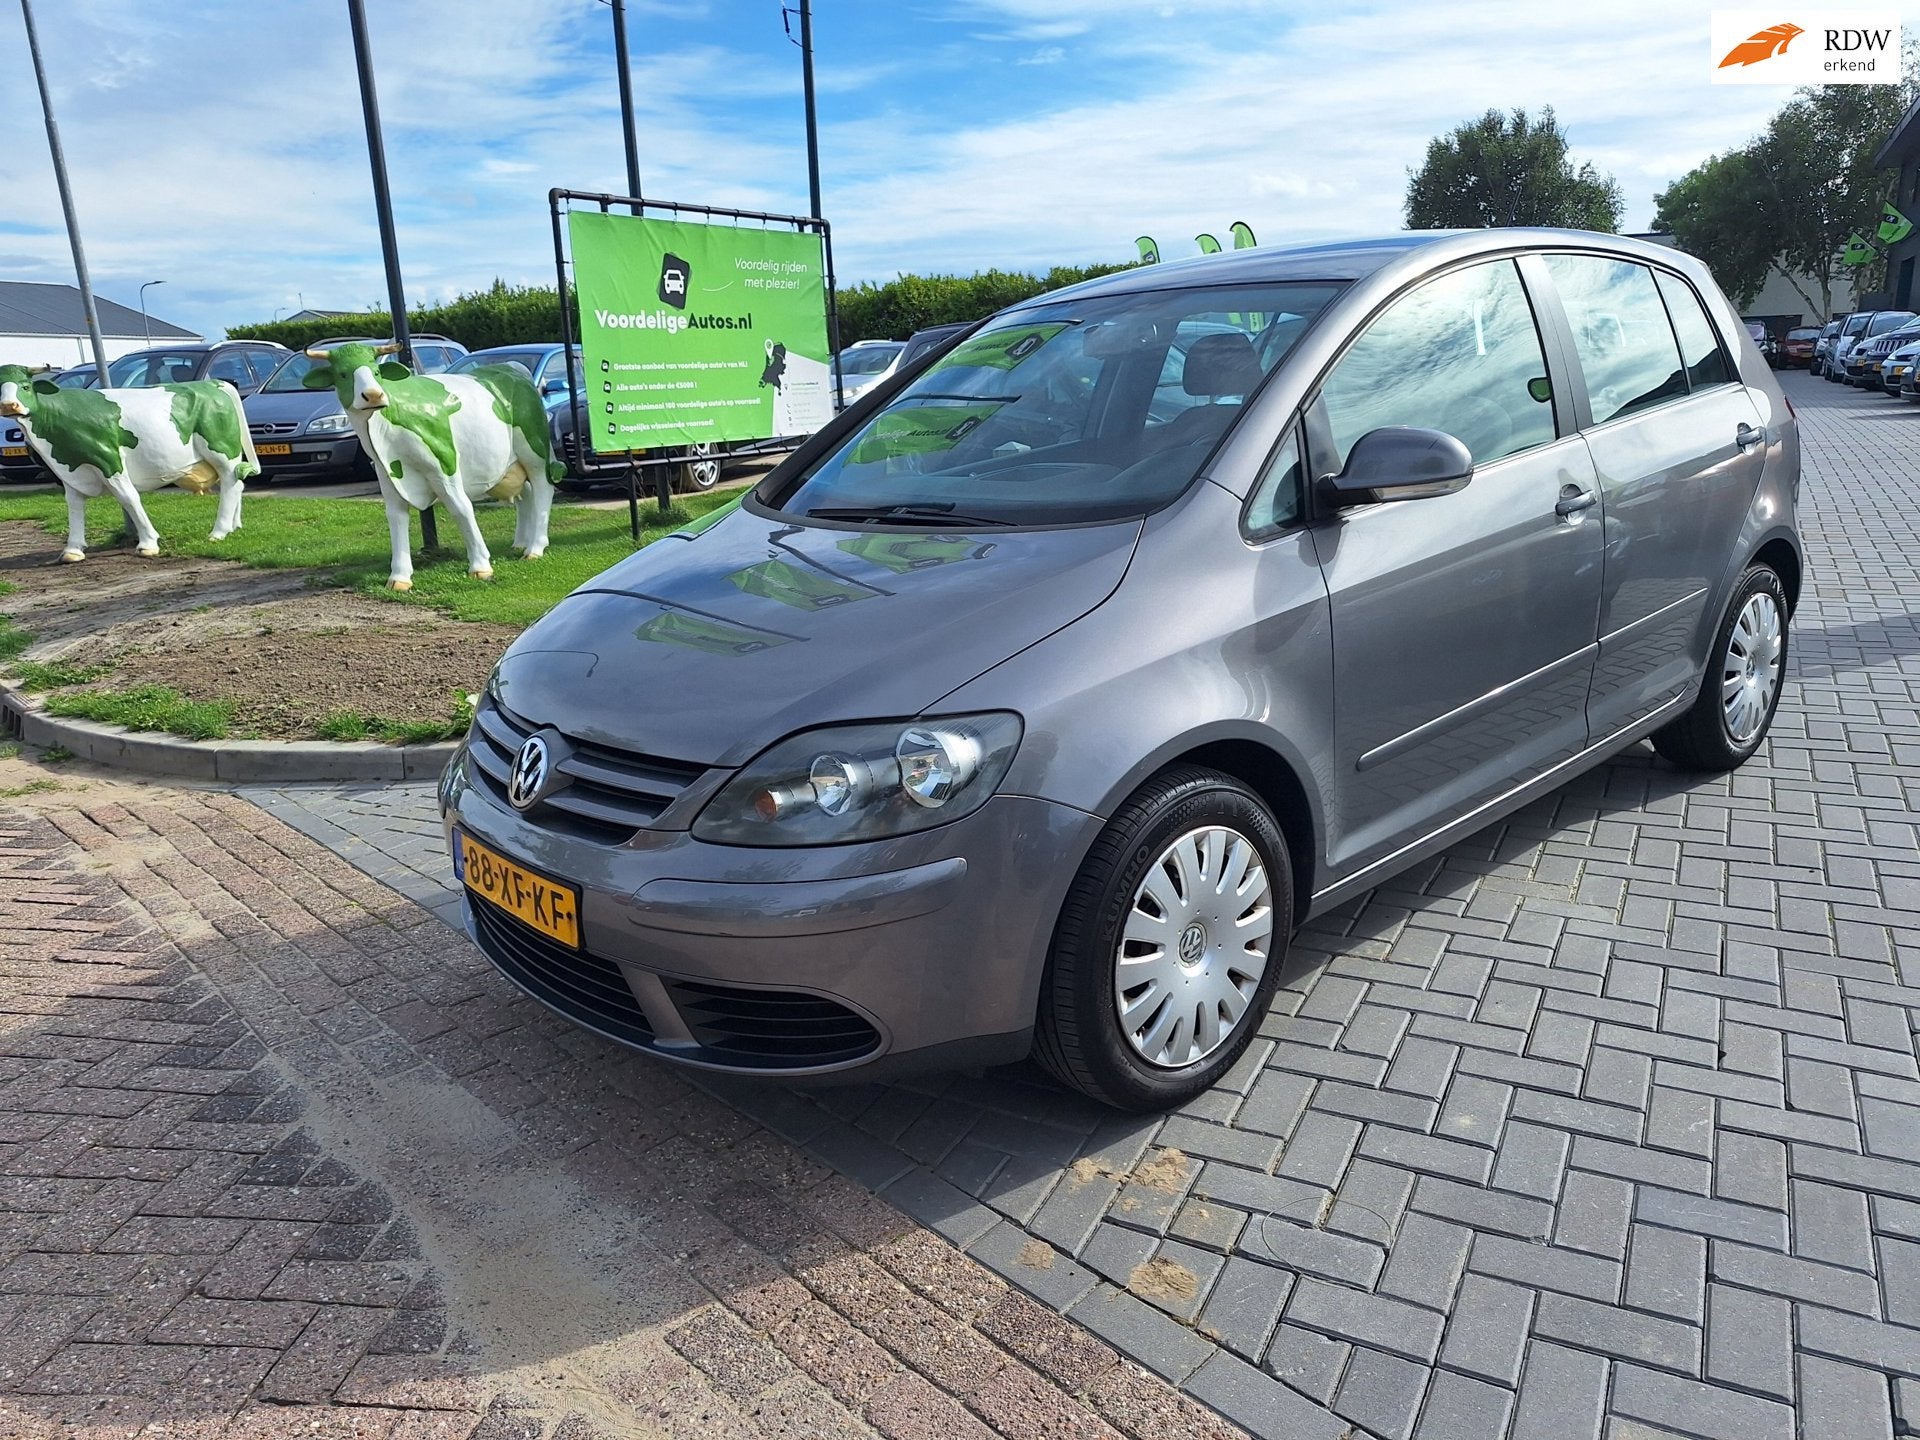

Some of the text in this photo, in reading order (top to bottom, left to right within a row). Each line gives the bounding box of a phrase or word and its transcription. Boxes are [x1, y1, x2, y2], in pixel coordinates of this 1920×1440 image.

[734, 257, 808, 276] Voordelig rijden
[744, 277, 800, 290] met plezier!
[594, 309, 753, 335] VoordeligeAutos.nl
[468, 845, 564, 931] 88-XF-KF
[1103, 845, 1150, 940] KUMHO
